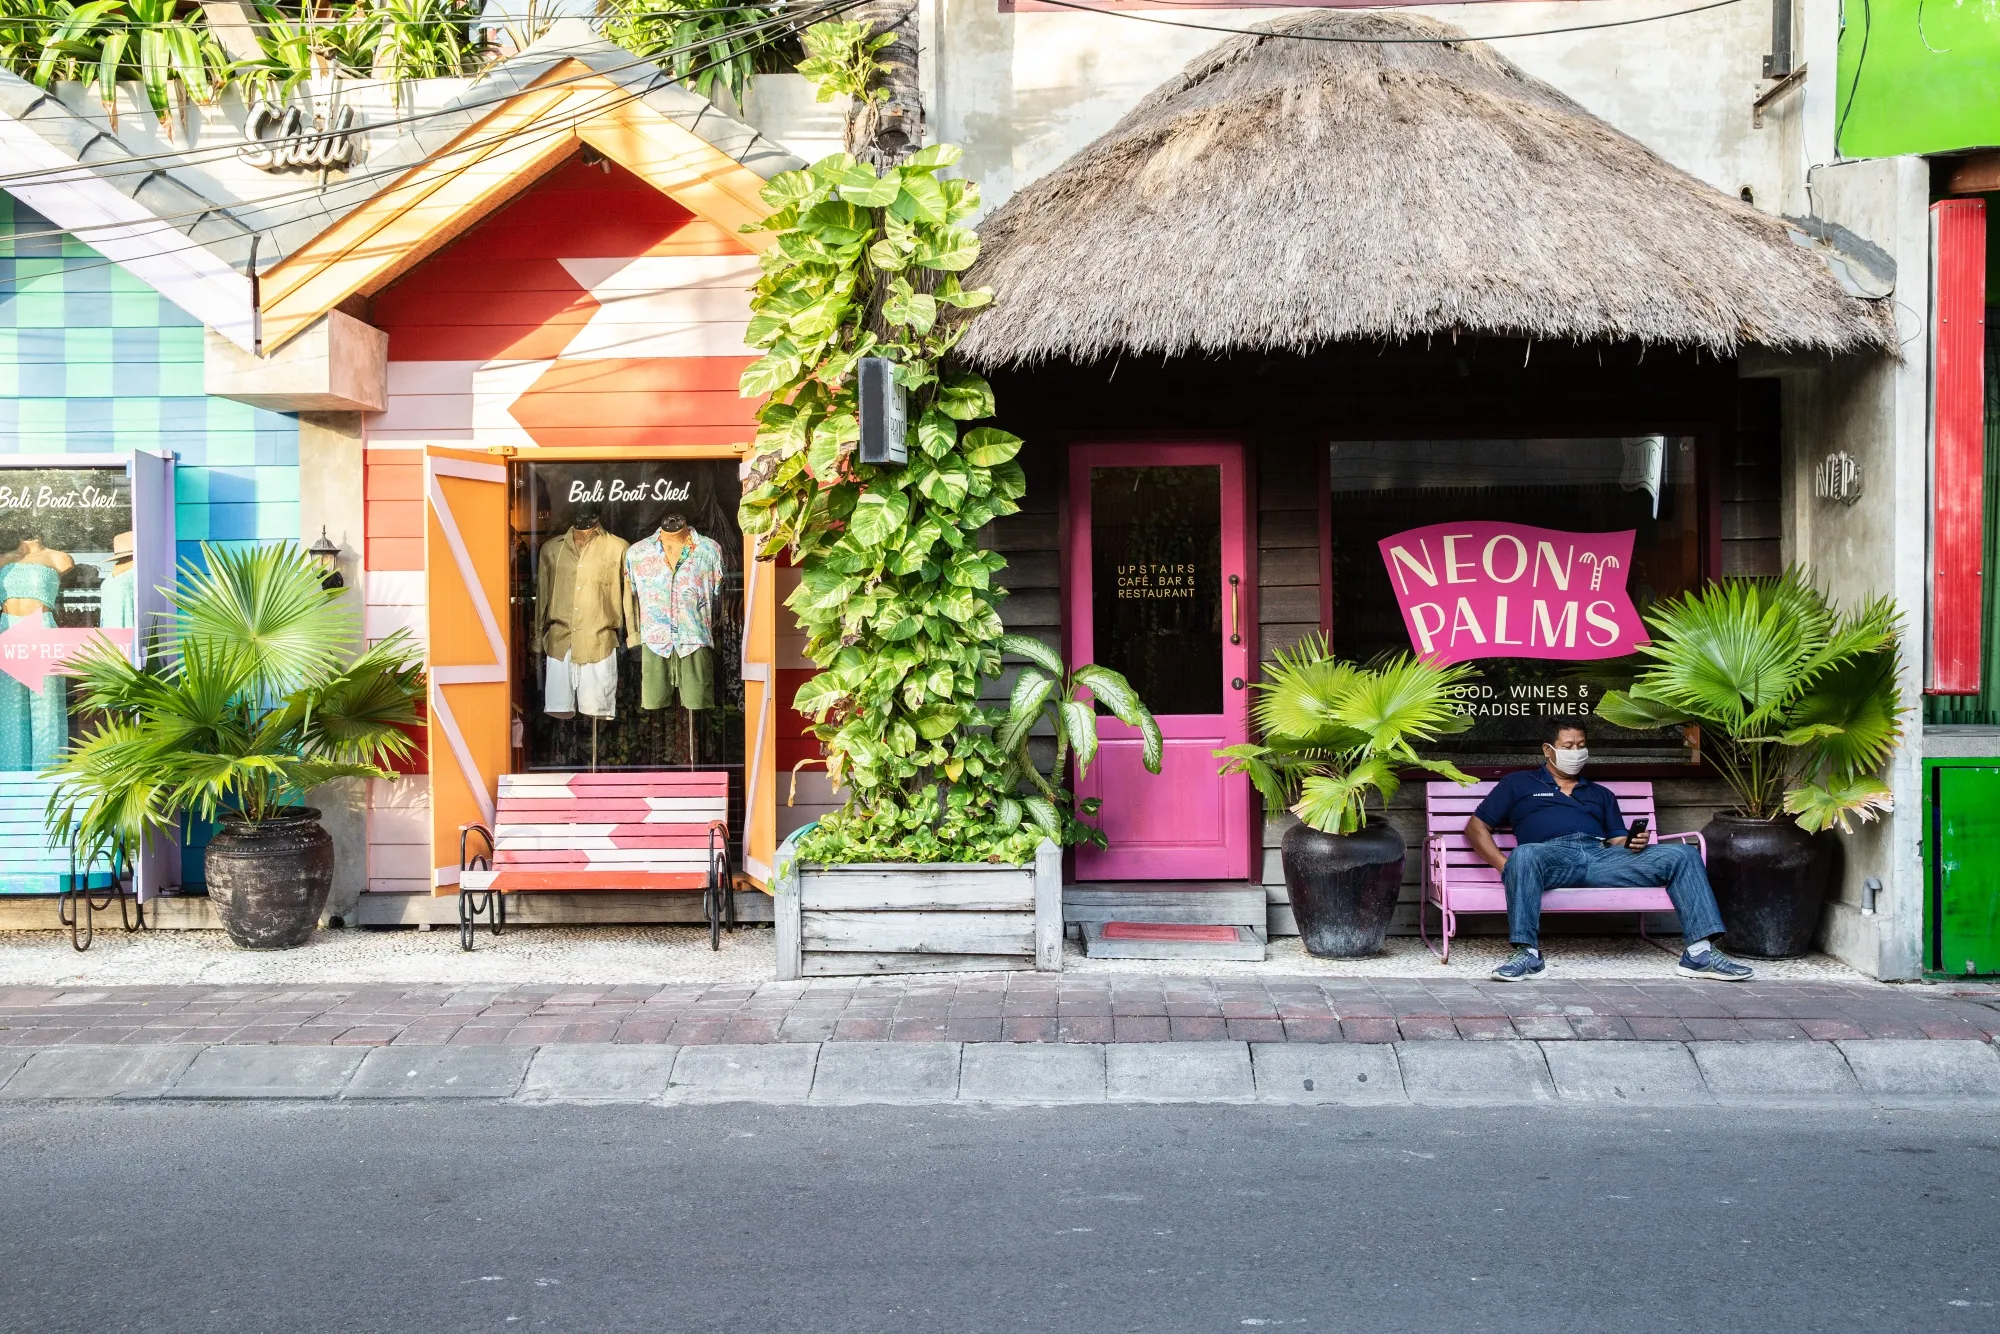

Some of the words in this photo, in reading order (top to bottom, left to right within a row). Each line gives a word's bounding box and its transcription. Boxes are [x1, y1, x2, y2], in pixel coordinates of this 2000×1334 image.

[0, 486, 33, 509] Bali
[36, 485, 80, 508] Boat
[78, 485, 118, 508] Shed
[568, 479, 605, 503] Bali
[608, 479, 651, 502] Boat
[650, 478, 691, 502] Shed
[1117, 564, 1195, 575] UPSTAIRS
[1389, 534, 1574, 596] NEON
[1158, 576, 1182, 586] BAR
[1187, 576, 1195, 586] &
[1118, 588, 1196, 599] RESTAURANT
[1409, 595, 1620, 654] PALMS
[3, 643, 65, 659] WE'RE
[1510, 685, 1568, 699] WINES
[1578, 685, 1589, 698] &
[1537, 702, 1590, 716] TIMES
